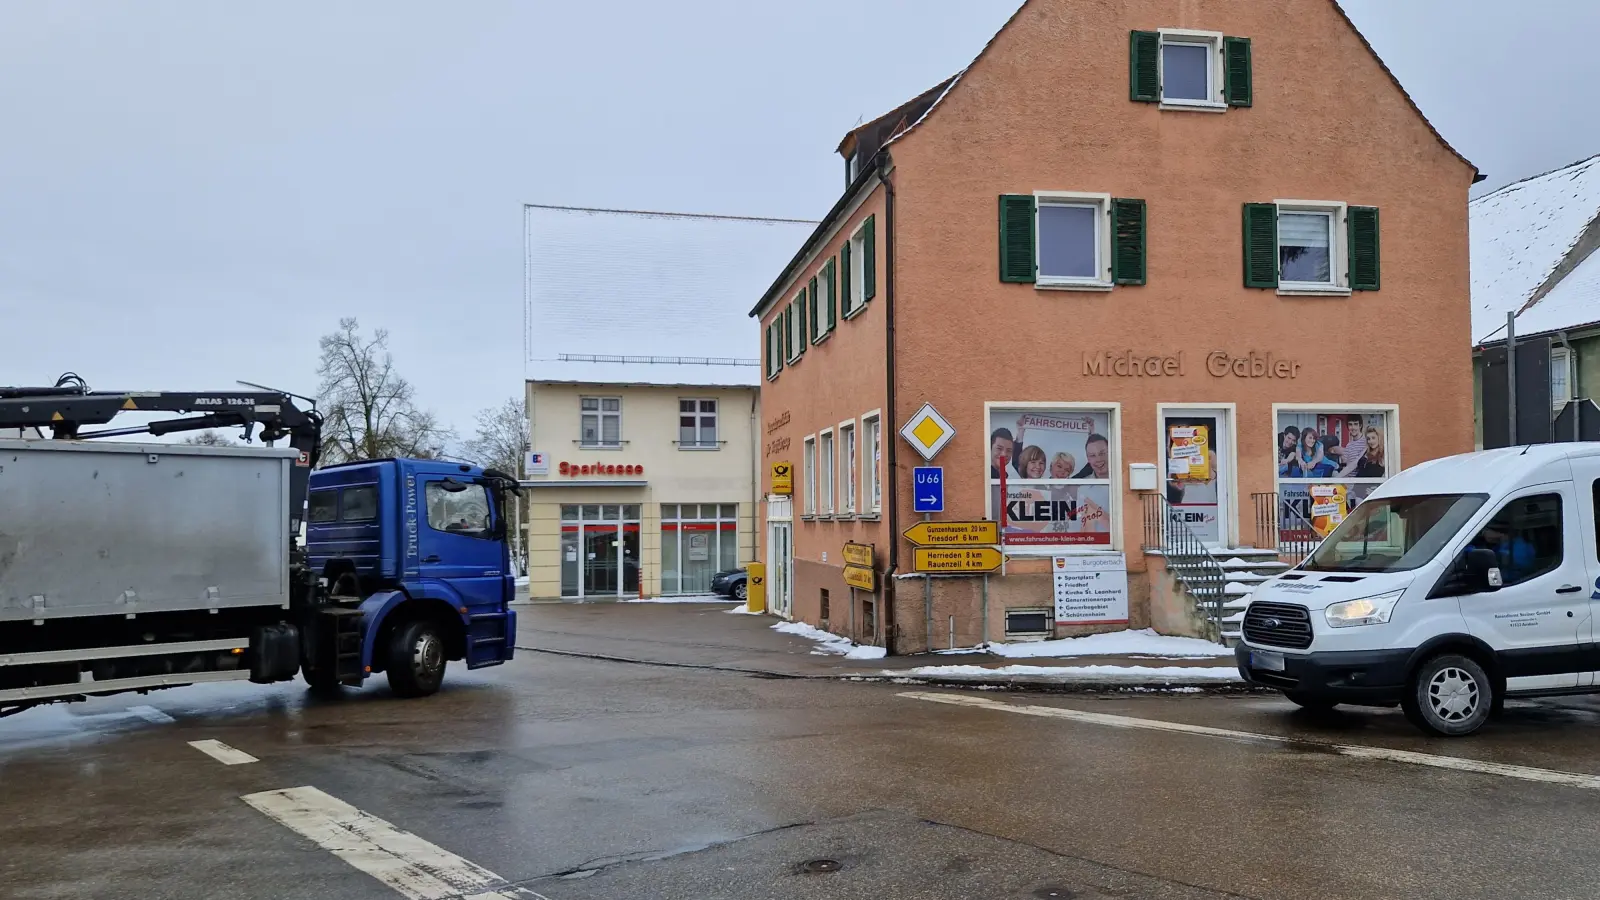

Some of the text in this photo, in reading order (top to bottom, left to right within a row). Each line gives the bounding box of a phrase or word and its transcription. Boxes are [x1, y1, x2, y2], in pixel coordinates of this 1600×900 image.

[1082, 350, 1300, 378] Michael Gabler
[1024, 417, 1088, 430] FAHRSCHULE
[559, 461, 644, 477] Sparkasse
[917, 473, 939, 484] U 66
[1283, 490, 1310, 498] Fahrschu
[405, 472, 418, 558] Truck-Power
[926, 526, 968, 534] Gunzenhausen
[979, 524, 988, 532] km
[927, 551, 962, 559] Herrieden
[927, 560, 962, 568] Rauenzell
[971, 560, 983, 568] km
